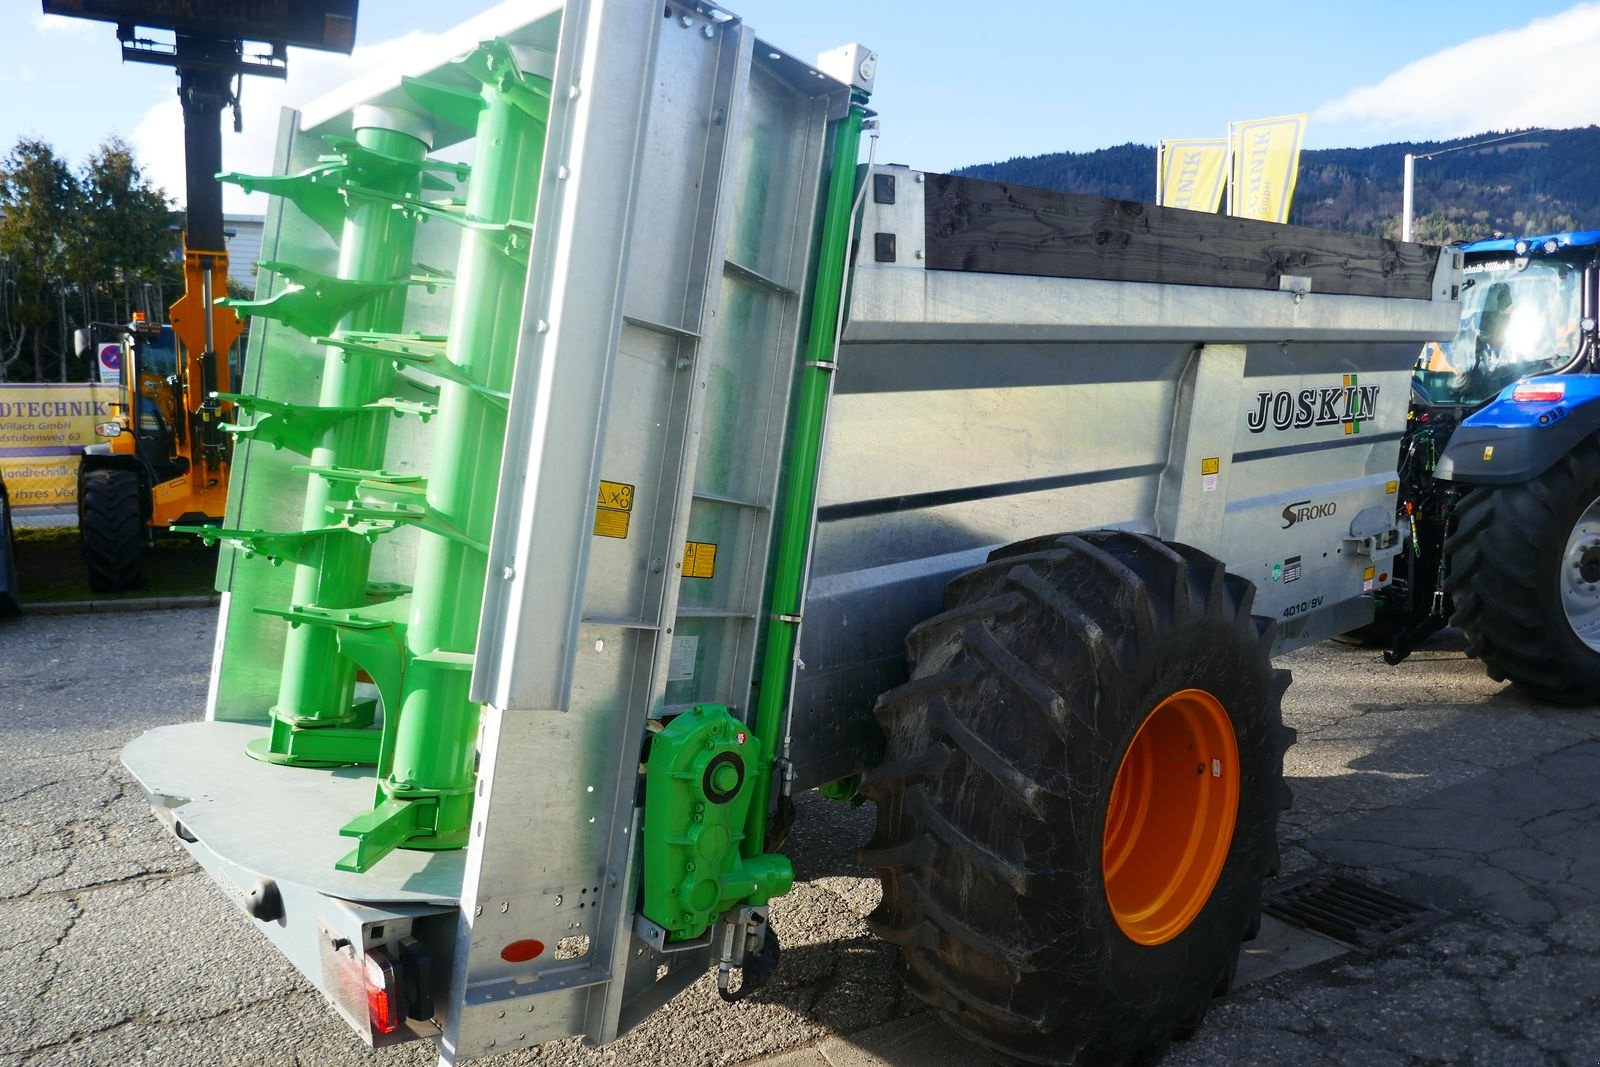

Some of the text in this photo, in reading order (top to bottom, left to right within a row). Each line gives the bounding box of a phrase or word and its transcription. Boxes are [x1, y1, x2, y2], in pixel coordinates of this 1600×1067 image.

[0, 401, 107, 418] DTECHNIK
[1247, 384, 1380, 433] JOSKIN
[38, 421, 72, 430] GmbH
[68, 432, 81, 441] 63
[15, 488, 49, 499] Ihres
[1282, 500, 1337, 529] SIROKO
[1283, 596, 1324, 617] 4010/9V
